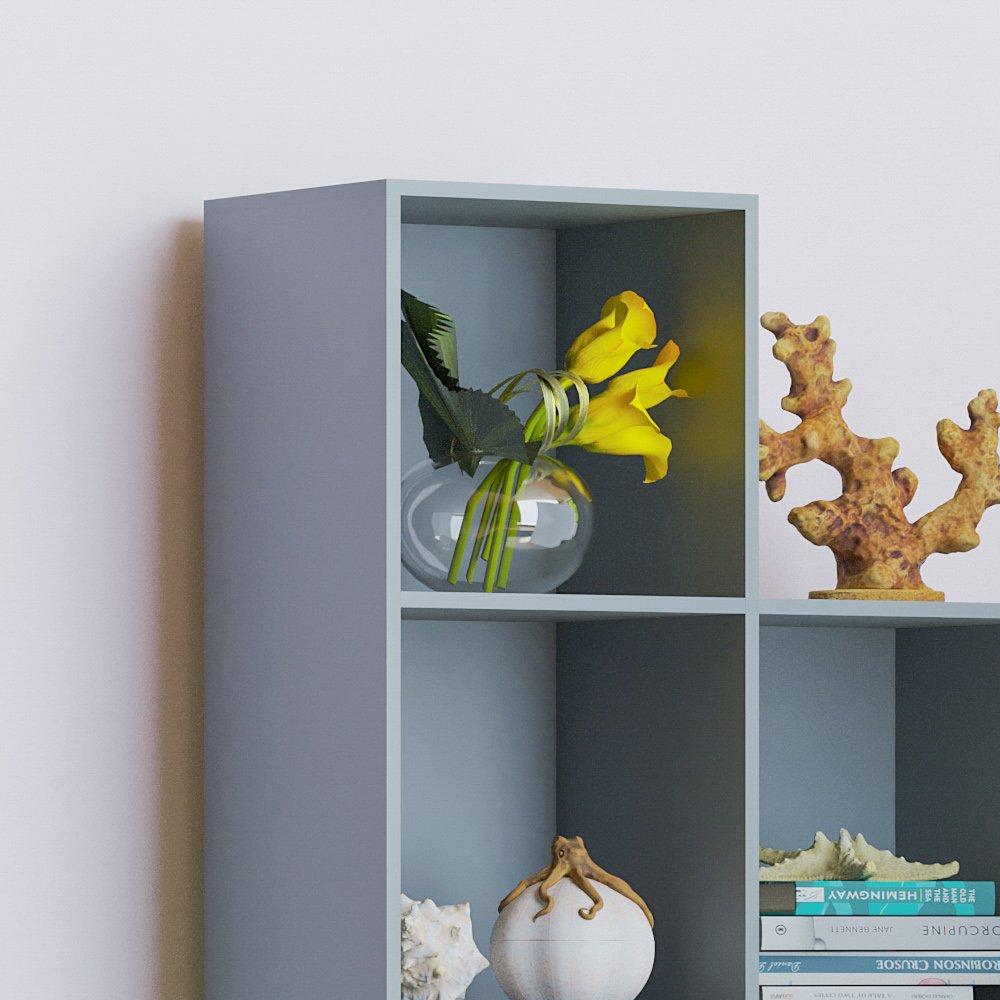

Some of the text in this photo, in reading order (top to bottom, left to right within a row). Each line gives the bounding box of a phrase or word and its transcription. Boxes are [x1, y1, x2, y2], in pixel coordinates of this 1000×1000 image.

[828, 891, 917, 901] HEMINGWAY
[831, 925, 893, 934] JANE BENNETT
[876, 959, 930, 971] CRUSOE
